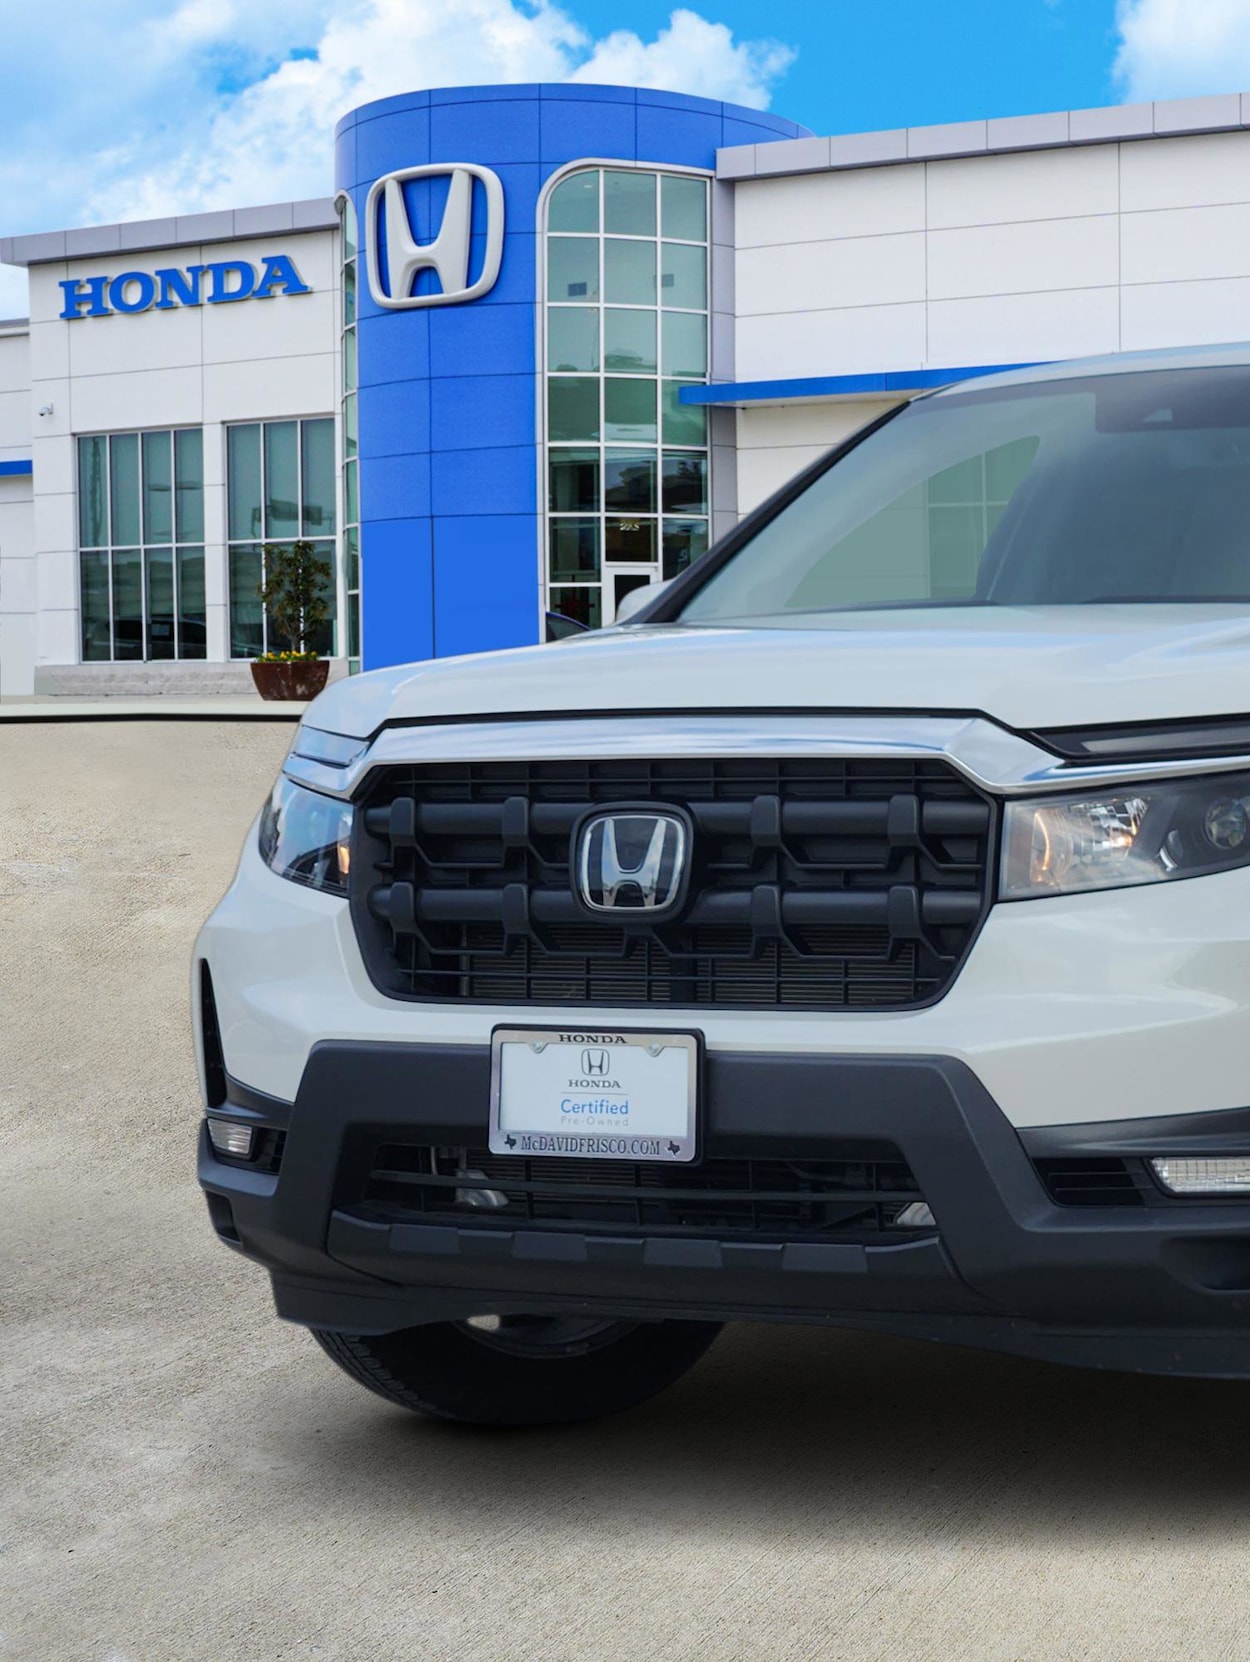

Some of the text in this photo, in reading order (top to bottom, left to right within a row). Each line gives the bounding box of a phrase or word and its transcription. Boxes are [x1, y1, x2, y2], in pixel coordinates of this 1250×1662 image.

[58, 254, 312, 320] HONDA
[558, 1034, 627, 1045] HONDA
[568, 1079, 622, 1089] HONDA
[560, 1098, 629, 1115] Certified
[560, 1115, 629, 1127] Pre-Owned
[521, 1135, 661, 1156] McDAVIDFRISCO.COM
